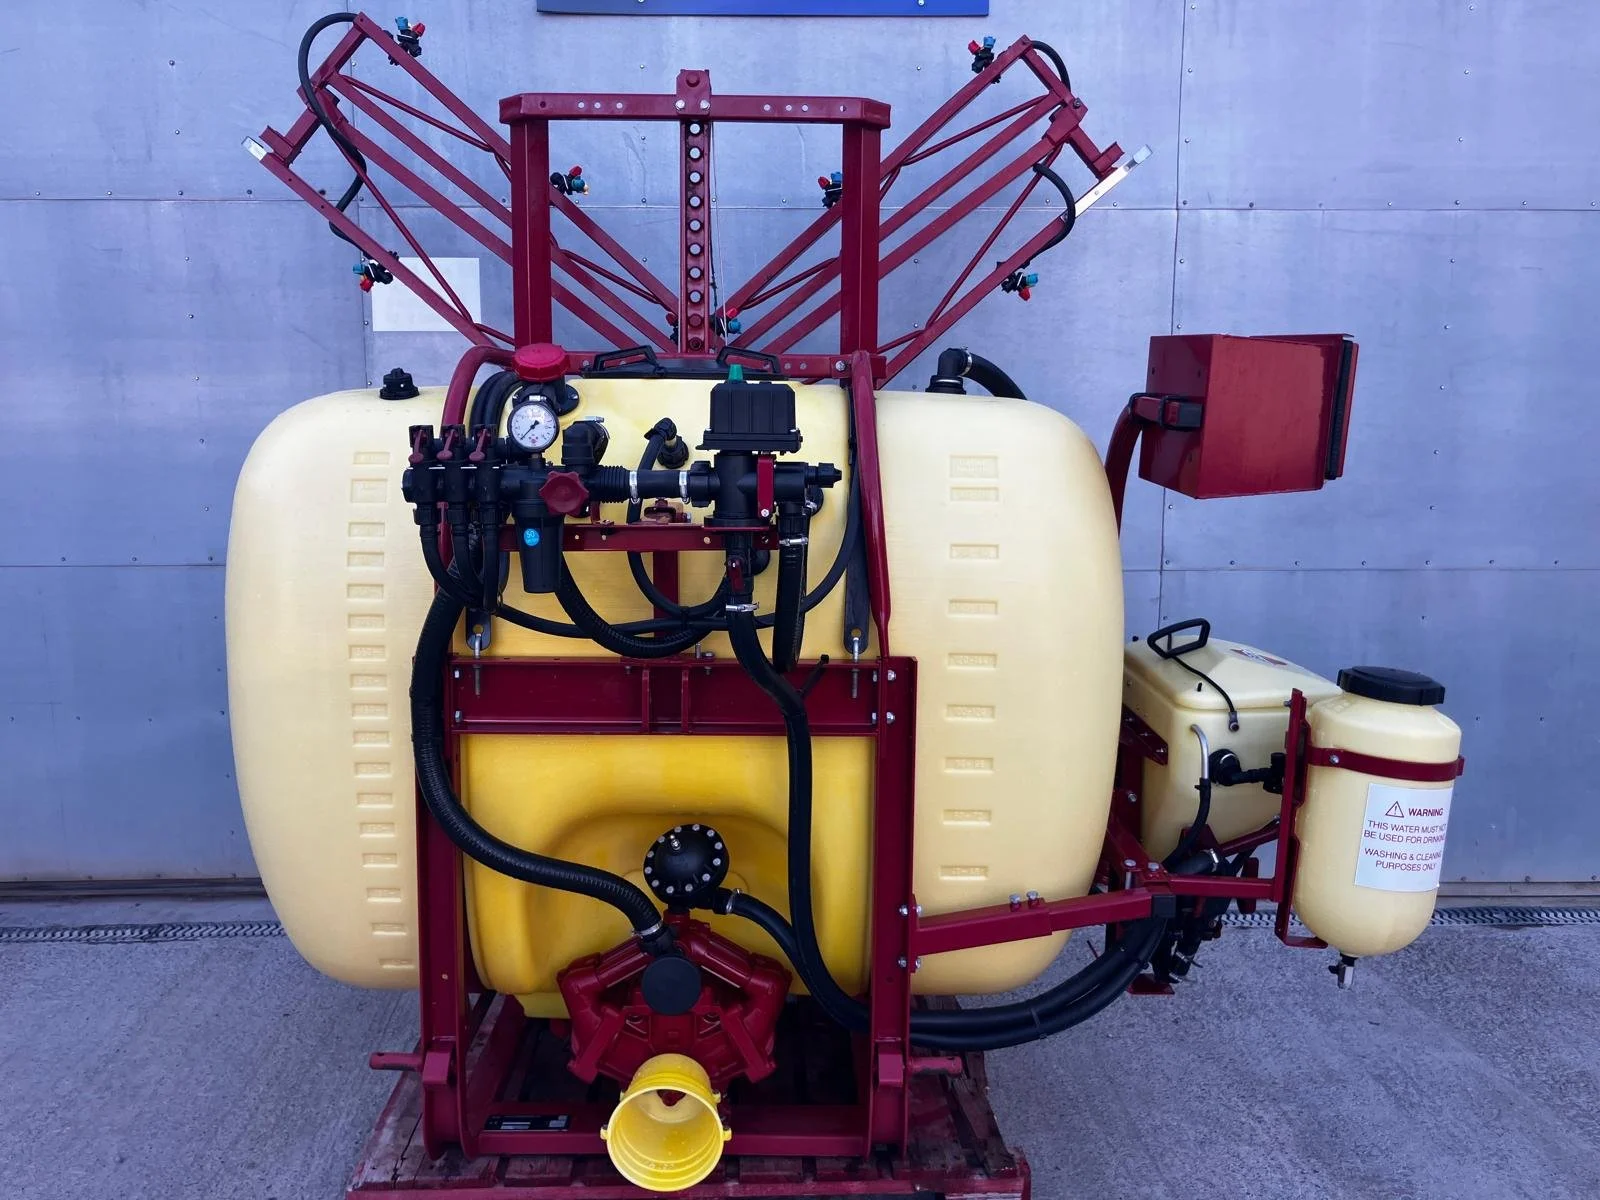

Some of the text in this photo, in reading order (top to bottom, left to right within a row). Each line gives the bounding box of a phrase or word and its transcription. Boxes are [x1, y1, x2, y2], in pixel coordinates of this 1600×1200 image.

[1408, 808, 1443, 816] WARNING
[1368, 820, 1389, 830] THIS
[1391, 824, 1420, 833] WATER
[1421, 825, 1438, 833] MUST
[1364, 830, 1376, 839] BE
[1379, 833, 1404, 842] USED
[1405, 836, 1422, 844] FOR
[1365, 848, 1407, 860] WASHING
[1376, 860, 1421, 871] PURPOSES
